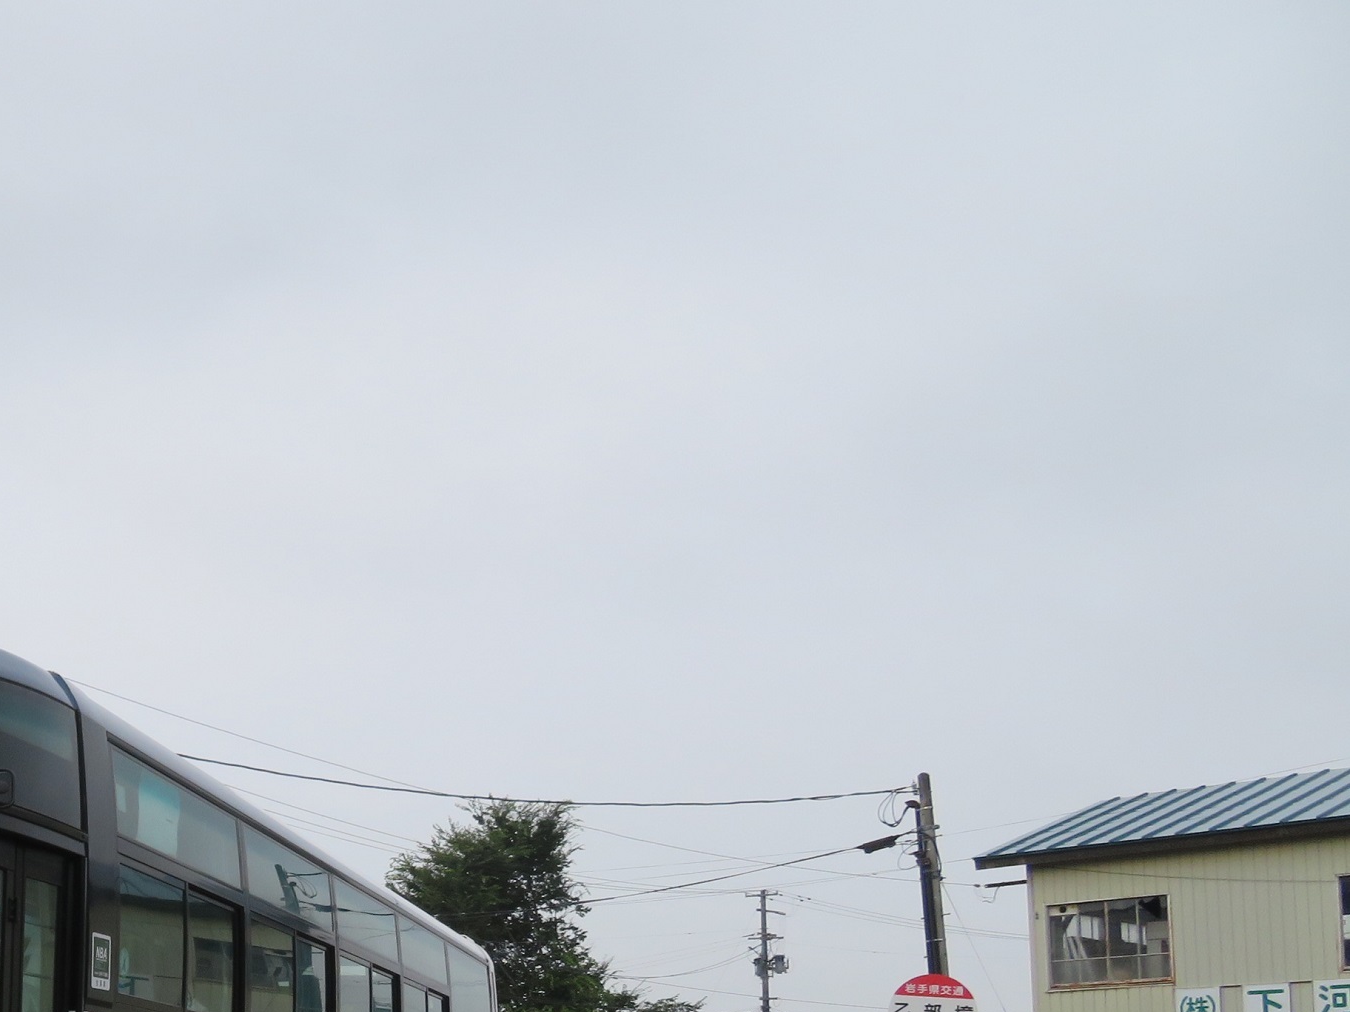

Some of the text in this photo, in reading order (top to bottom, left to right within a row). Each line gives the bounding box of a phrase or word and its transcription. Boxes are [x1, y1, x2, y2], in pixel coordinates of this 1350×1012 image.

[904, 983, 965, 996] 岩手県交通
